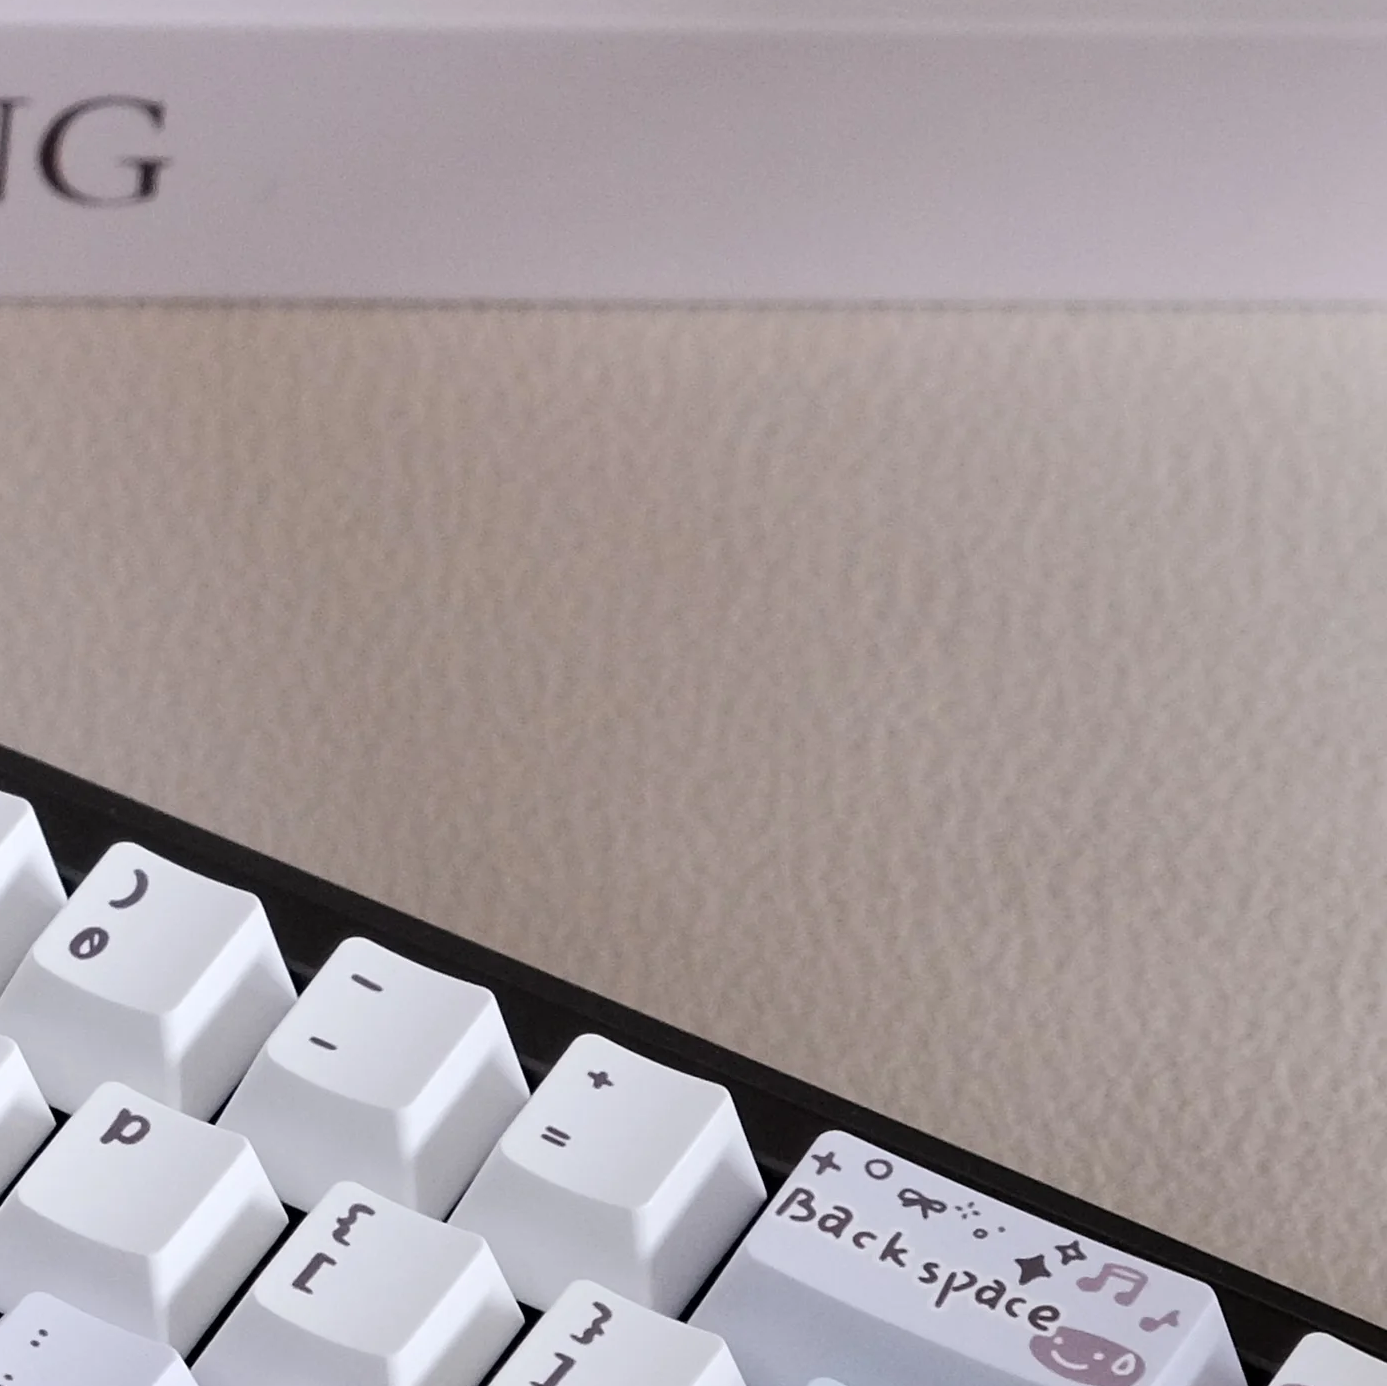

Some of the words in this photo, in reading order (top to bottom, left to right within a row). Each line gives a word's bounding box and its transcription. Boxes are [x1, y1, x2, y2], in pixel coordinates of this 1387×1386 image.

[109, 869, 148, 909] )
[69, 927, 109, 960] 0
[587, 1071, 614, 1089] +
[541, 1126, 571, 1147] =
[332, 1204, 375, 1246] {
[292, 1253, 337, 1294] [
[776, 1186, 1063, 1333] Backspace
[570, 1302, 612, 1345] }
